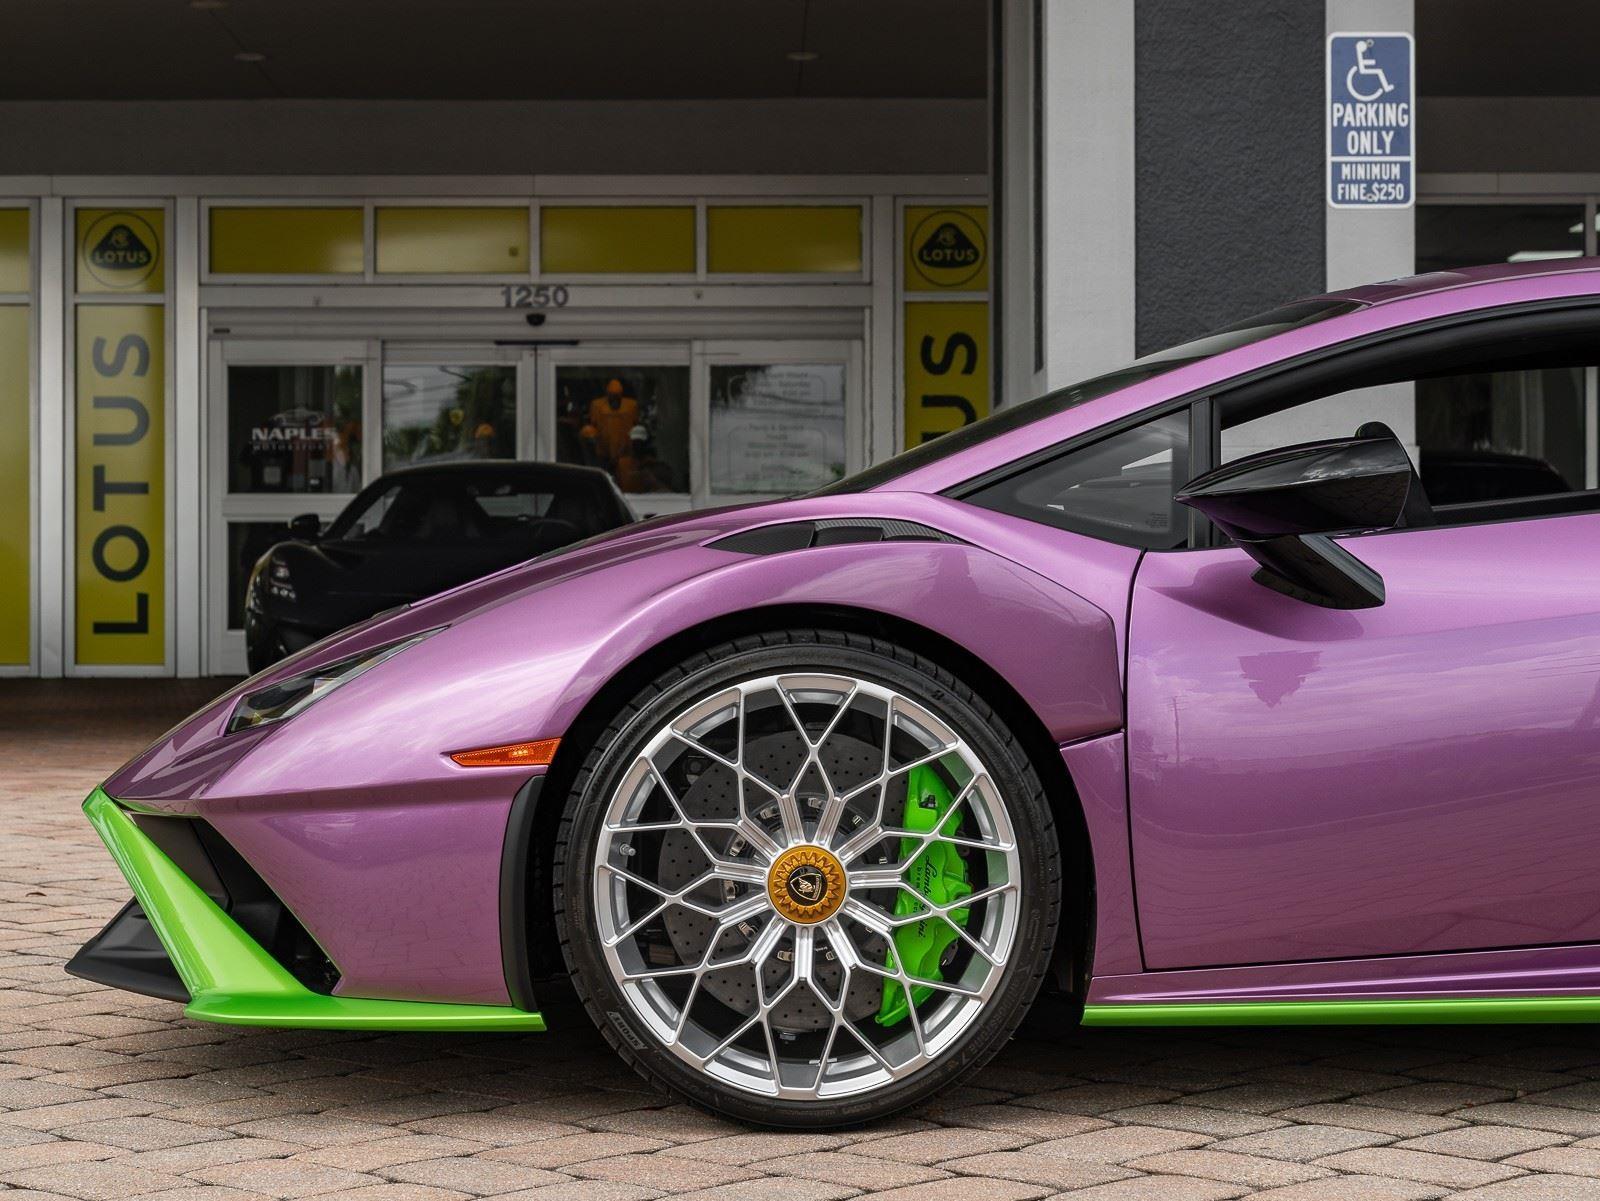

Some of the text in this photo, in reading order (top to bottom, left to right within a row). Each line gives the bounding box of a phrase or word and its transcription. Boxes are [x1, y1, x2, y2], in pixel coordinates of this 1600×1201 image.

[1332, 103, 1409, 127] PARKING
[1346, 130, 1395, 155] ONLY
[1341, 163, 1401, 180] MINIMUM
[1337, 182, 1404, 202] FINE $250
[95, 250, 148, 263] LOTUS
[922, 249, 975, 262] LOTUS
[501, 286, 568, 308] 1250
[920, 332, 978, 442] US
[93, 333, 150, 634] LOTUS
[918, 855, 938, 938] Lambgini
